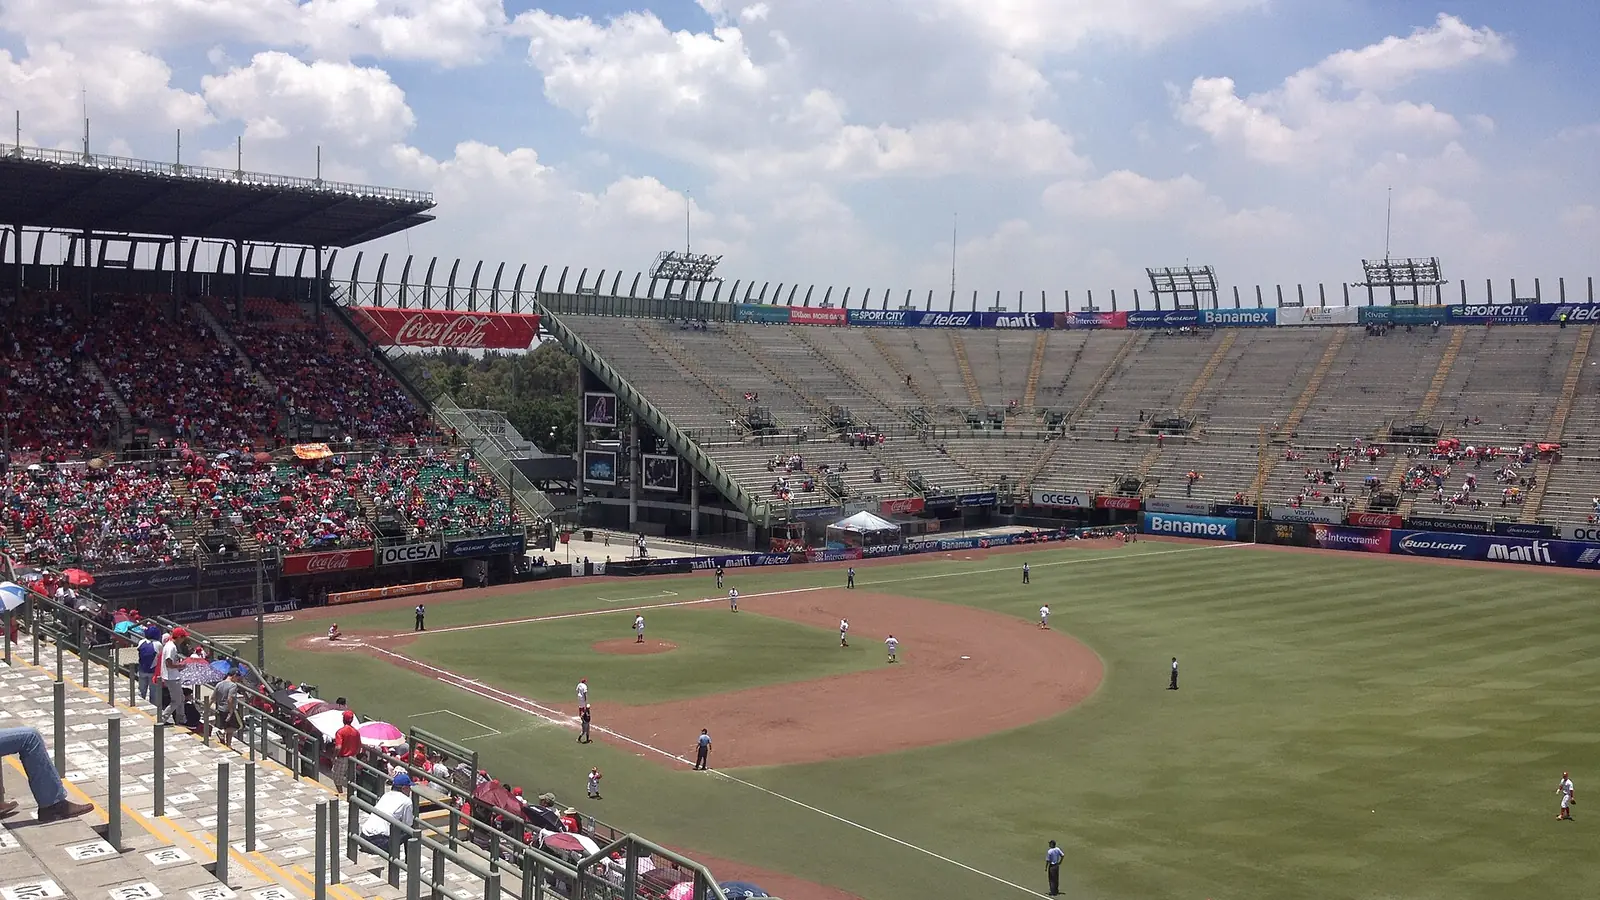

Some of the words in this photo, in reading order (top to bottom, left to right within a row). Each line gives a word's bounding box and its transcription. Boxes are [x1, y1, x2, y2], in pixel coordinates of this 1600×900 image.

[859, 310, 886, 321] SPORT
[886, 311, 905, 321] CITY
[1205, 311, 1268, 323] Banamex
[1464, 306, 1500, 316] SPORT
[1501, 306, 1528, 316] CITY
[933, 313, 972, 326] telcel
[395, 313, 493, 347] Coca-Cola
[1041, 493, 1080, 506] OCESA
[1104, 498, 1131, 508] Coca-Cola
[1358, 513, 1391, 526] Coca-Cola
[1411, 520, 1432, 528] VISITA
[1151, 516, 1227, 536] Banamex
[1328, 531, 1380, 546] Interceramic
[869, 545, 888, 553] SPORT
[888, 544, 901, 552] CITY
[908, 543, 926, 551] SPORT
[926, 541, 940, 549] CITY
[941, 540, 973, 550] Banamex
[1404, 539, 1431, 550] BUD
[1430, 541, 1467, 551] LIGHT
[385, 544, 439, 563] OCESA
[307, 553, 351, 571] Coca-Cola
[764, 555, 791, 565] telcel
